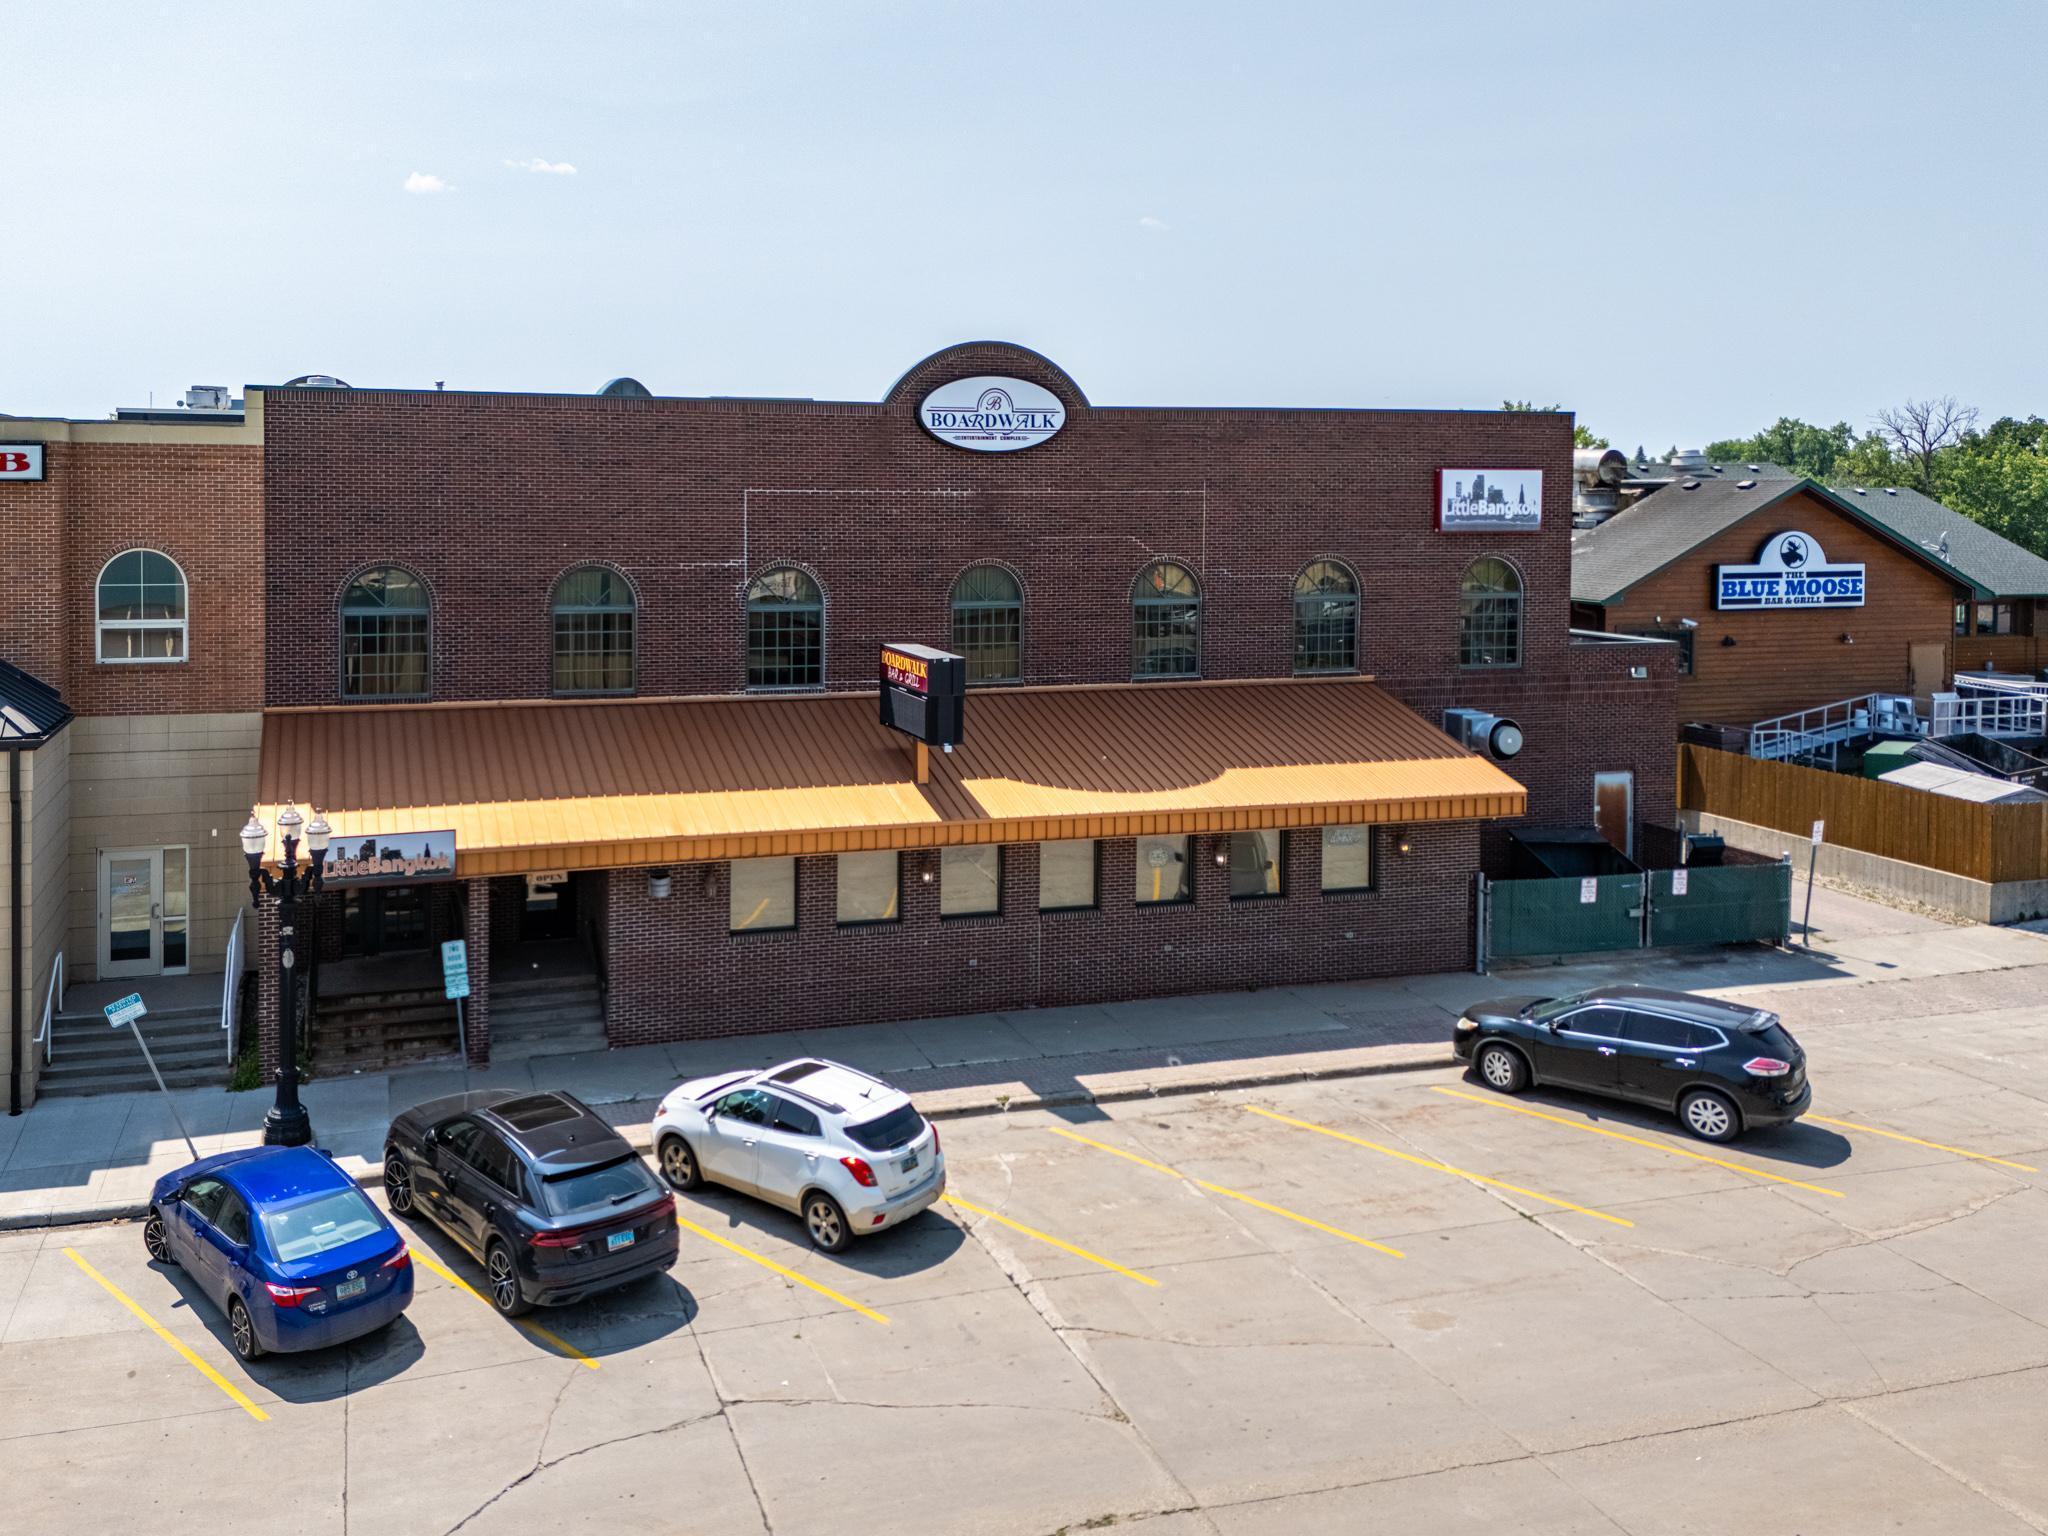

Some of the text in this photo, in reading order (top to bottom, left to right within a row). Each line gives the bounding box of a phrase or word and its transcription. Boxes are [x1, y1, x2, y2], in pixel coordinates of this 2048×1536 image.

[986, 396, 1002, 411] B
[931, 413, 1056, 434] BOARDWALK
[1784, 571, 1804, 579] THE
[1721, 578, 1863, 597] BLUE MOOSE
[1764, 597, 1783, 605] BAR
[1793, 596, 1822, 604] GRILL
[881, 649, 927, 678] BOARDWALK
[887, 666, 899, 680] BAR
[904, 673, 920, 688] GRILL
